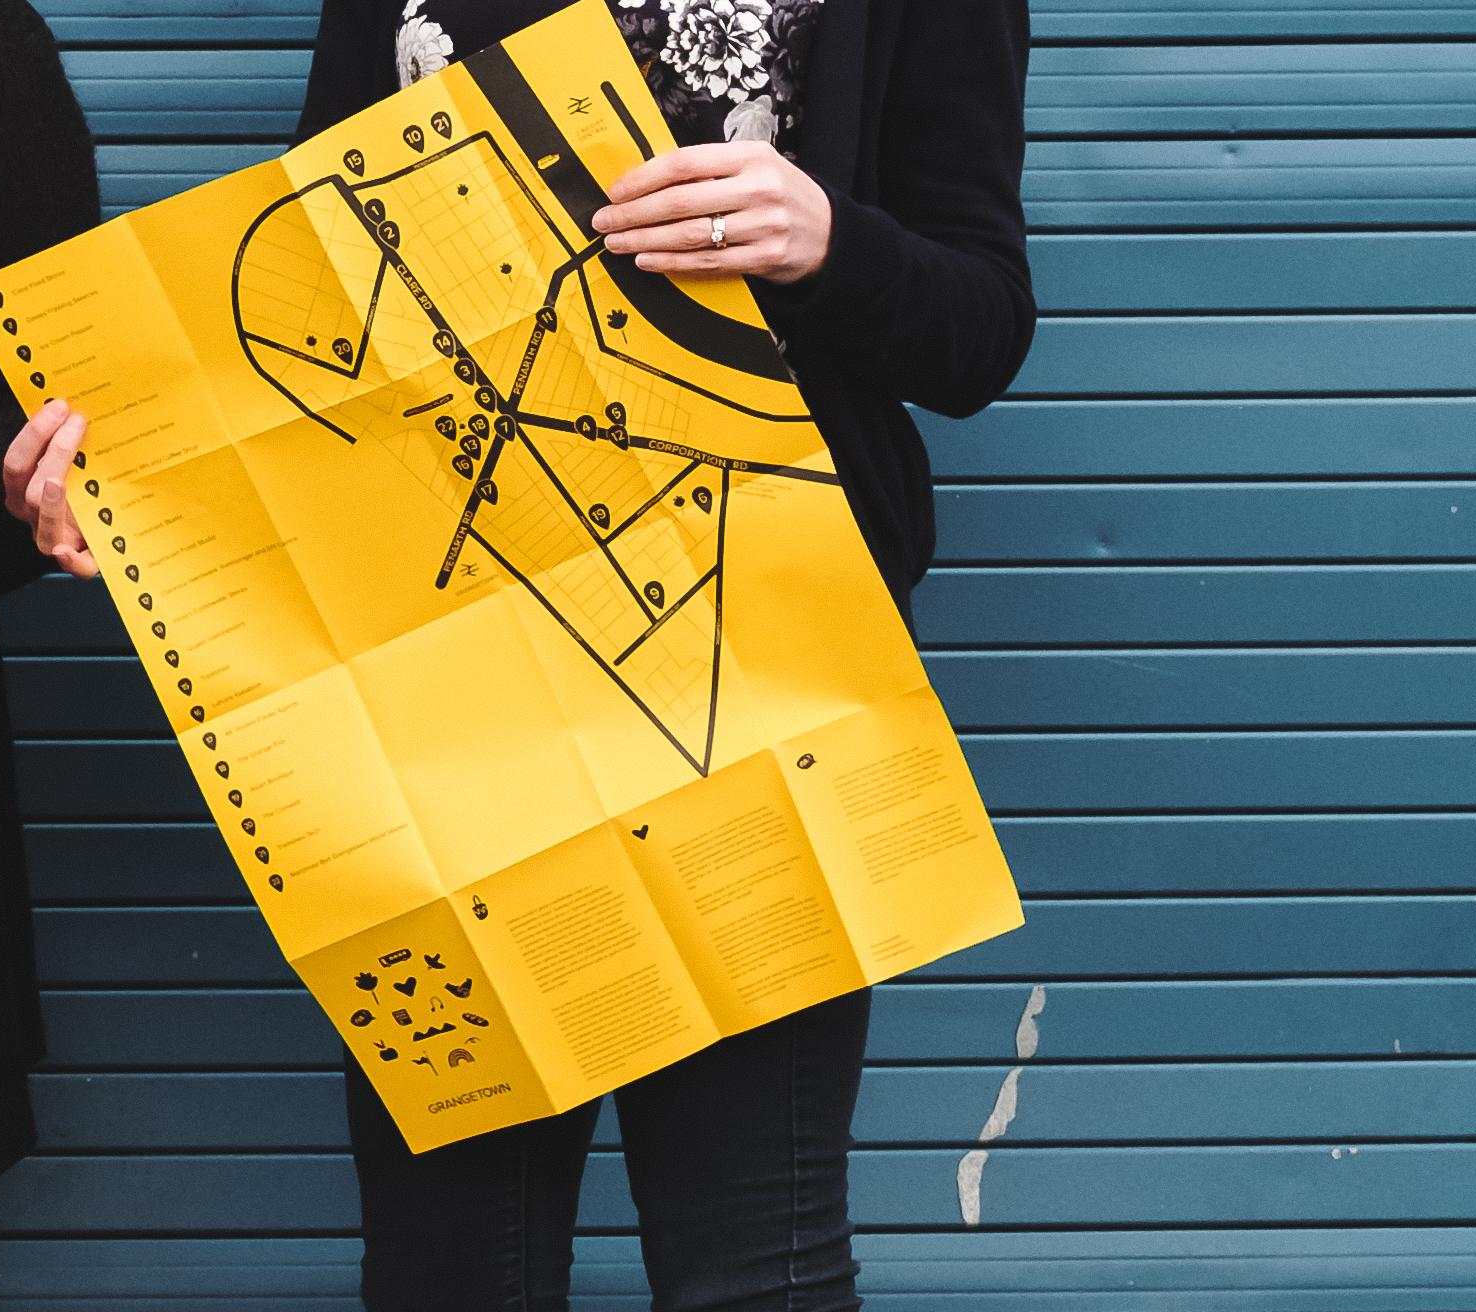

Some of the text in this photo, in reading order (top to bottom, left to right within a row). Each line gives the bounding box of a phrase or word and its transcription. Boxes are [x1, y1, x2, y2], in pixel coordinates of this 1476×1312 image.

[433, 115, 450, 132] 21
[405, 130, 422, 144] 10
[346, 153, 362, 169] 15
[370, 205, 380, 216] 1
[383, 226, 395, 240] 2
[396, 264, 433, 310] CLARE RD
[541, 312, 553, 323] 11
[335, 342, 351, 356] 20
[436, 335, 451, 349] 14
[513, 330, 543, 395] PENARTH RD
[459, 365, 471, 377] 3
[612, 407, 622, 420] 5
[437, 420, 454, 434] 22
[470, 419, 485, 433] 18
[501, 422, 509, 433] 7
[582, 422, 591, 432] 4
[610, 430, 625, 442] 12
[463, 439, 478, 451] 13
[648, 440, 748, 471] CORPORATION RD
[455, 458, 470, 471] 16
[480, 483, 492, 497] 17
[697, 492, 708, 503] 6
[592, 508, 606, 521] 19
[443, 510, 475, 572] PENARTH RD
[649, 588, 659, 599] 9
[428, 1082, 512, 1114] GRANGETOWN
